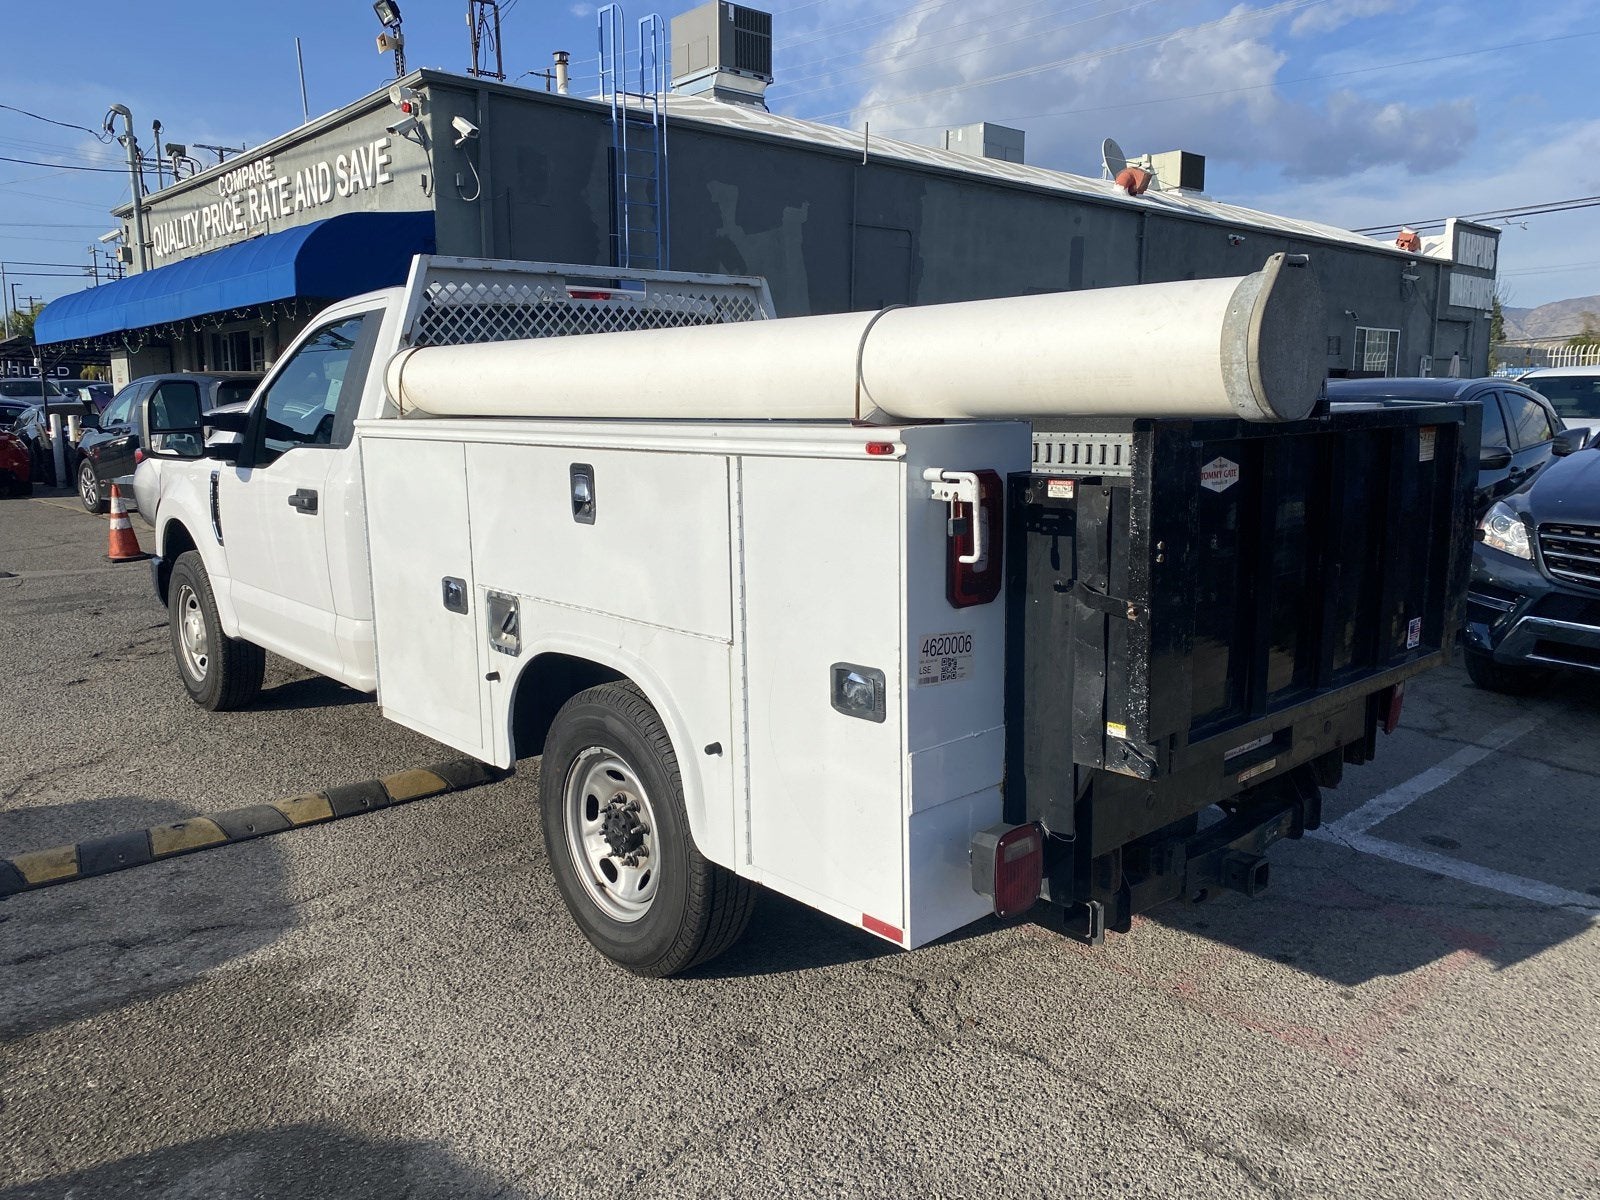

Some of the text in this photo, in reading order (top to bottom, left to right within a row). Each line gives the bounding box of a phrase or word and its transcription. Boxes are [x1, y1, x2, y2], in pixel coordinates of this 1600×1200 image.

[218, 156, 275, 198] COMPARE
[249, 176, 292, 226] RATE
[295, 161, 335, 212] AND
[336, 137, 393, 197] SAVE
[1201, 469, 1237, 480] TOMMY GATE
[922, 634, 972, 657] 4620006
[919, 666, 931, 675] LSE
